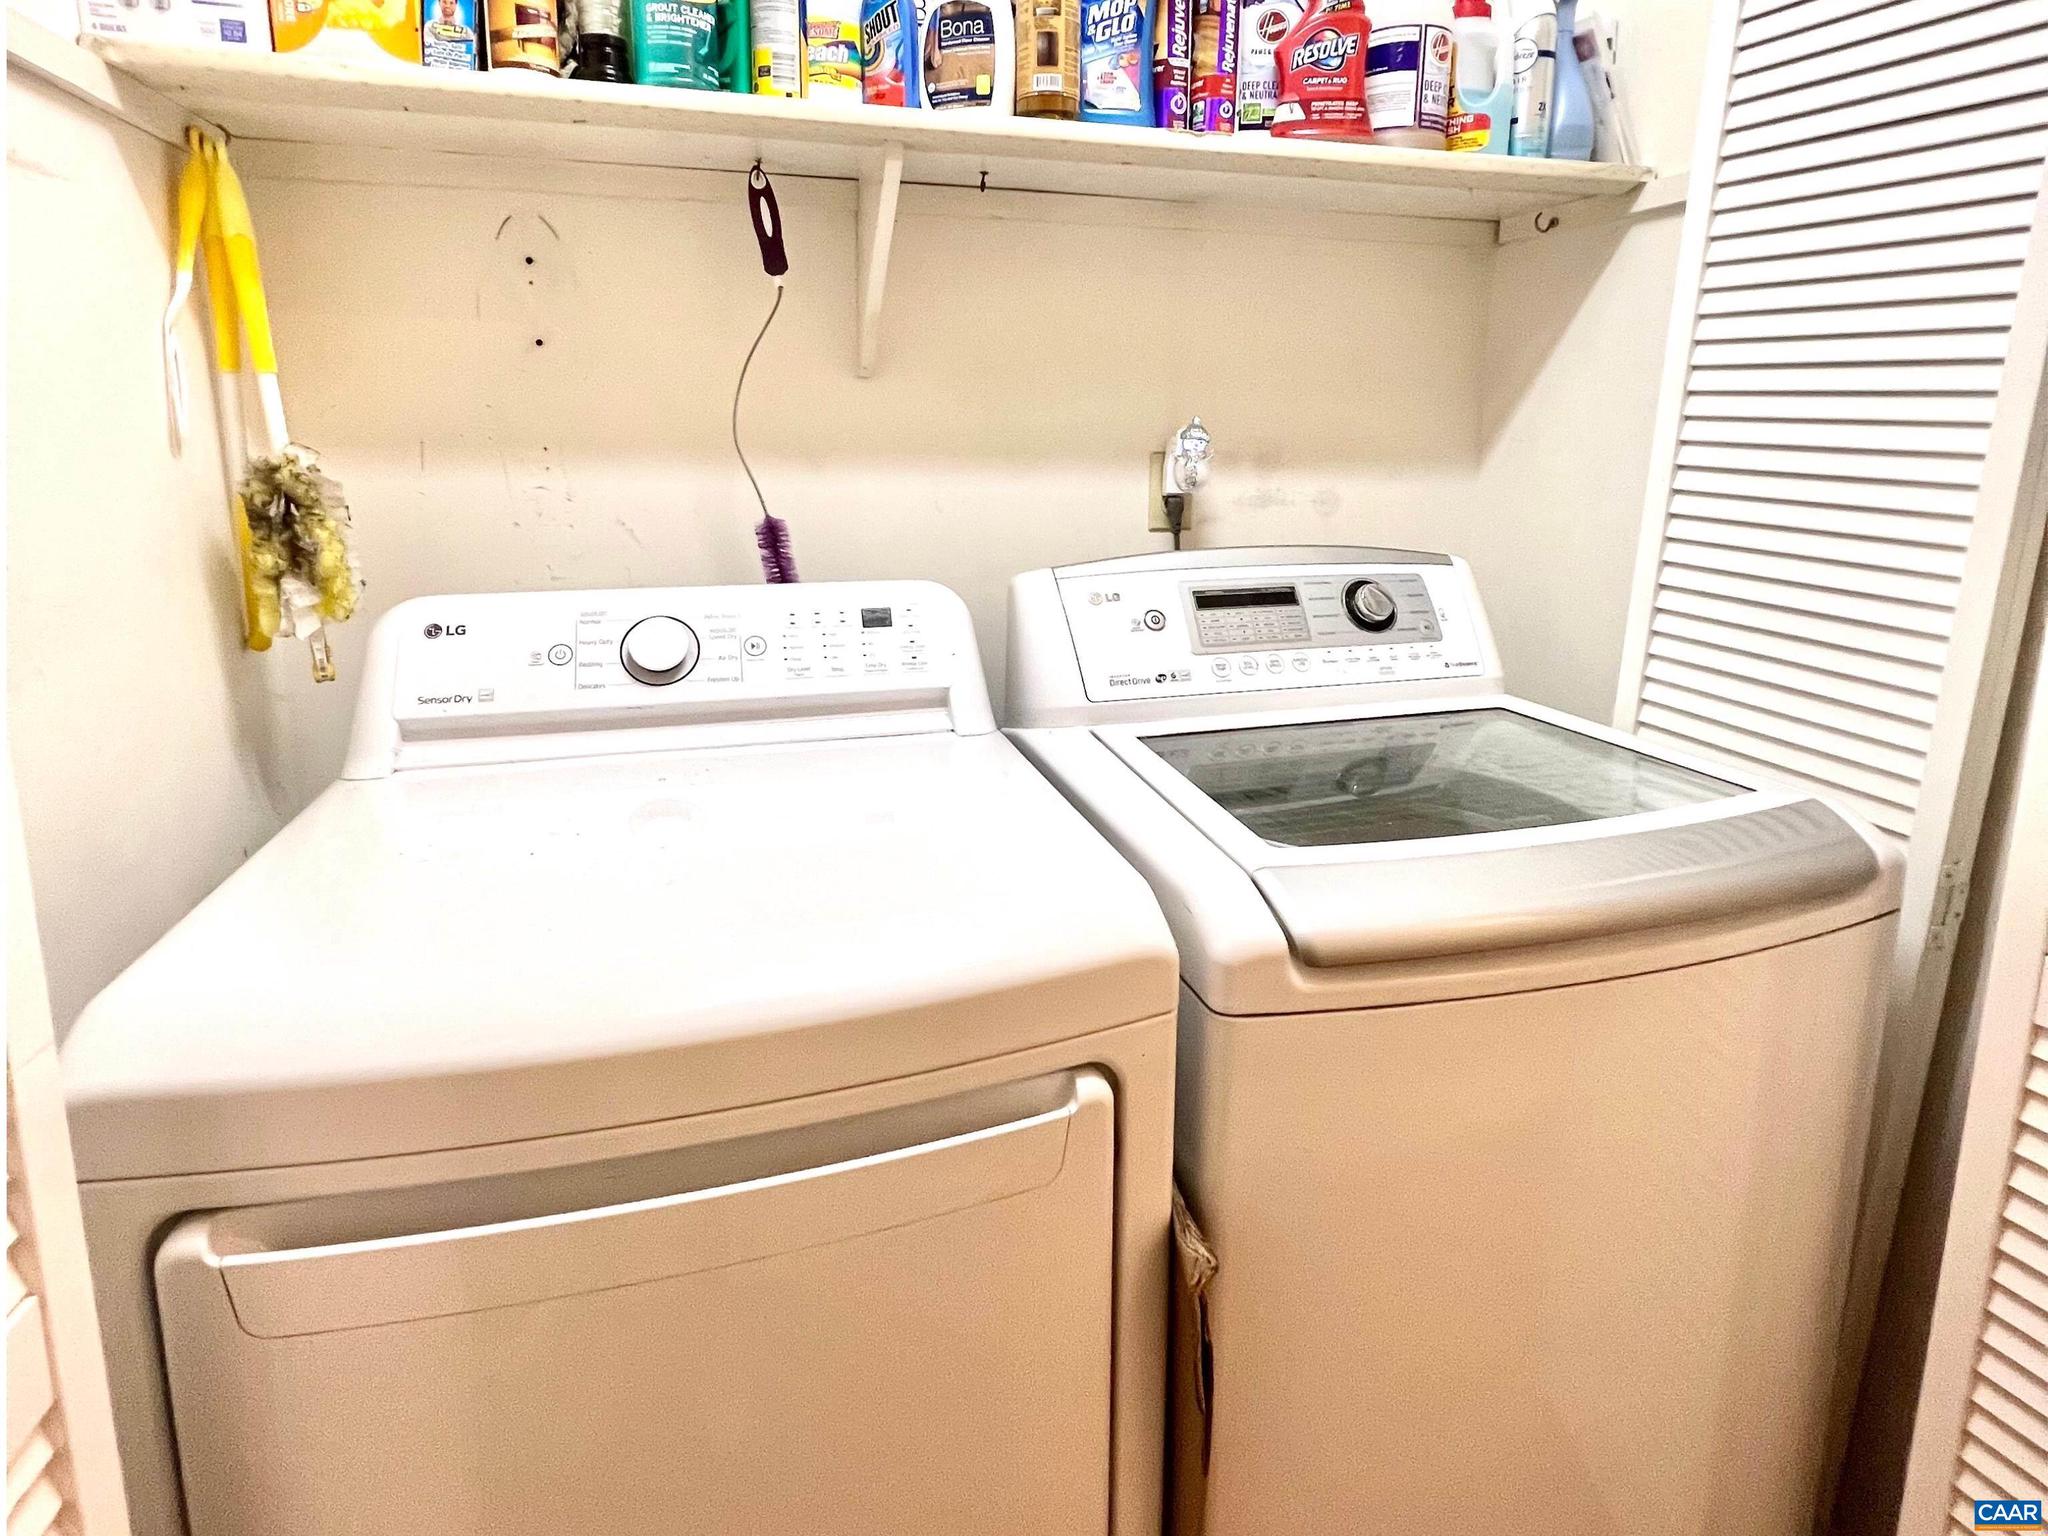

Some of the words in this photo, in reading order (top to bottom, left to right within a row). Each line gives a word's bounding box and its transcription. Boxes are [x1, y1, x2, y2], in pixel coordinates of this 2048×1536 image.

[645, 3, 678, 13] GROUT
[1087, 0, 1138, 25] MOP
[865, 1, 899, 44] SHOUT
[940, 19, 984, 38] Bona
[1095, 11, 1137, 43] GLO
[1172, 0, 1187, 57] Rejuve
[1291, 35, 1359, 70] RESOLVE
[1242, 81, 1261, 91] DEEP
[1303, 77, 1329, 85] CARPET
[1424, 80, 1442, 92] DEEP
[1105, 592, 1120, 602] LG
[446, 625, 466, 636] LG
